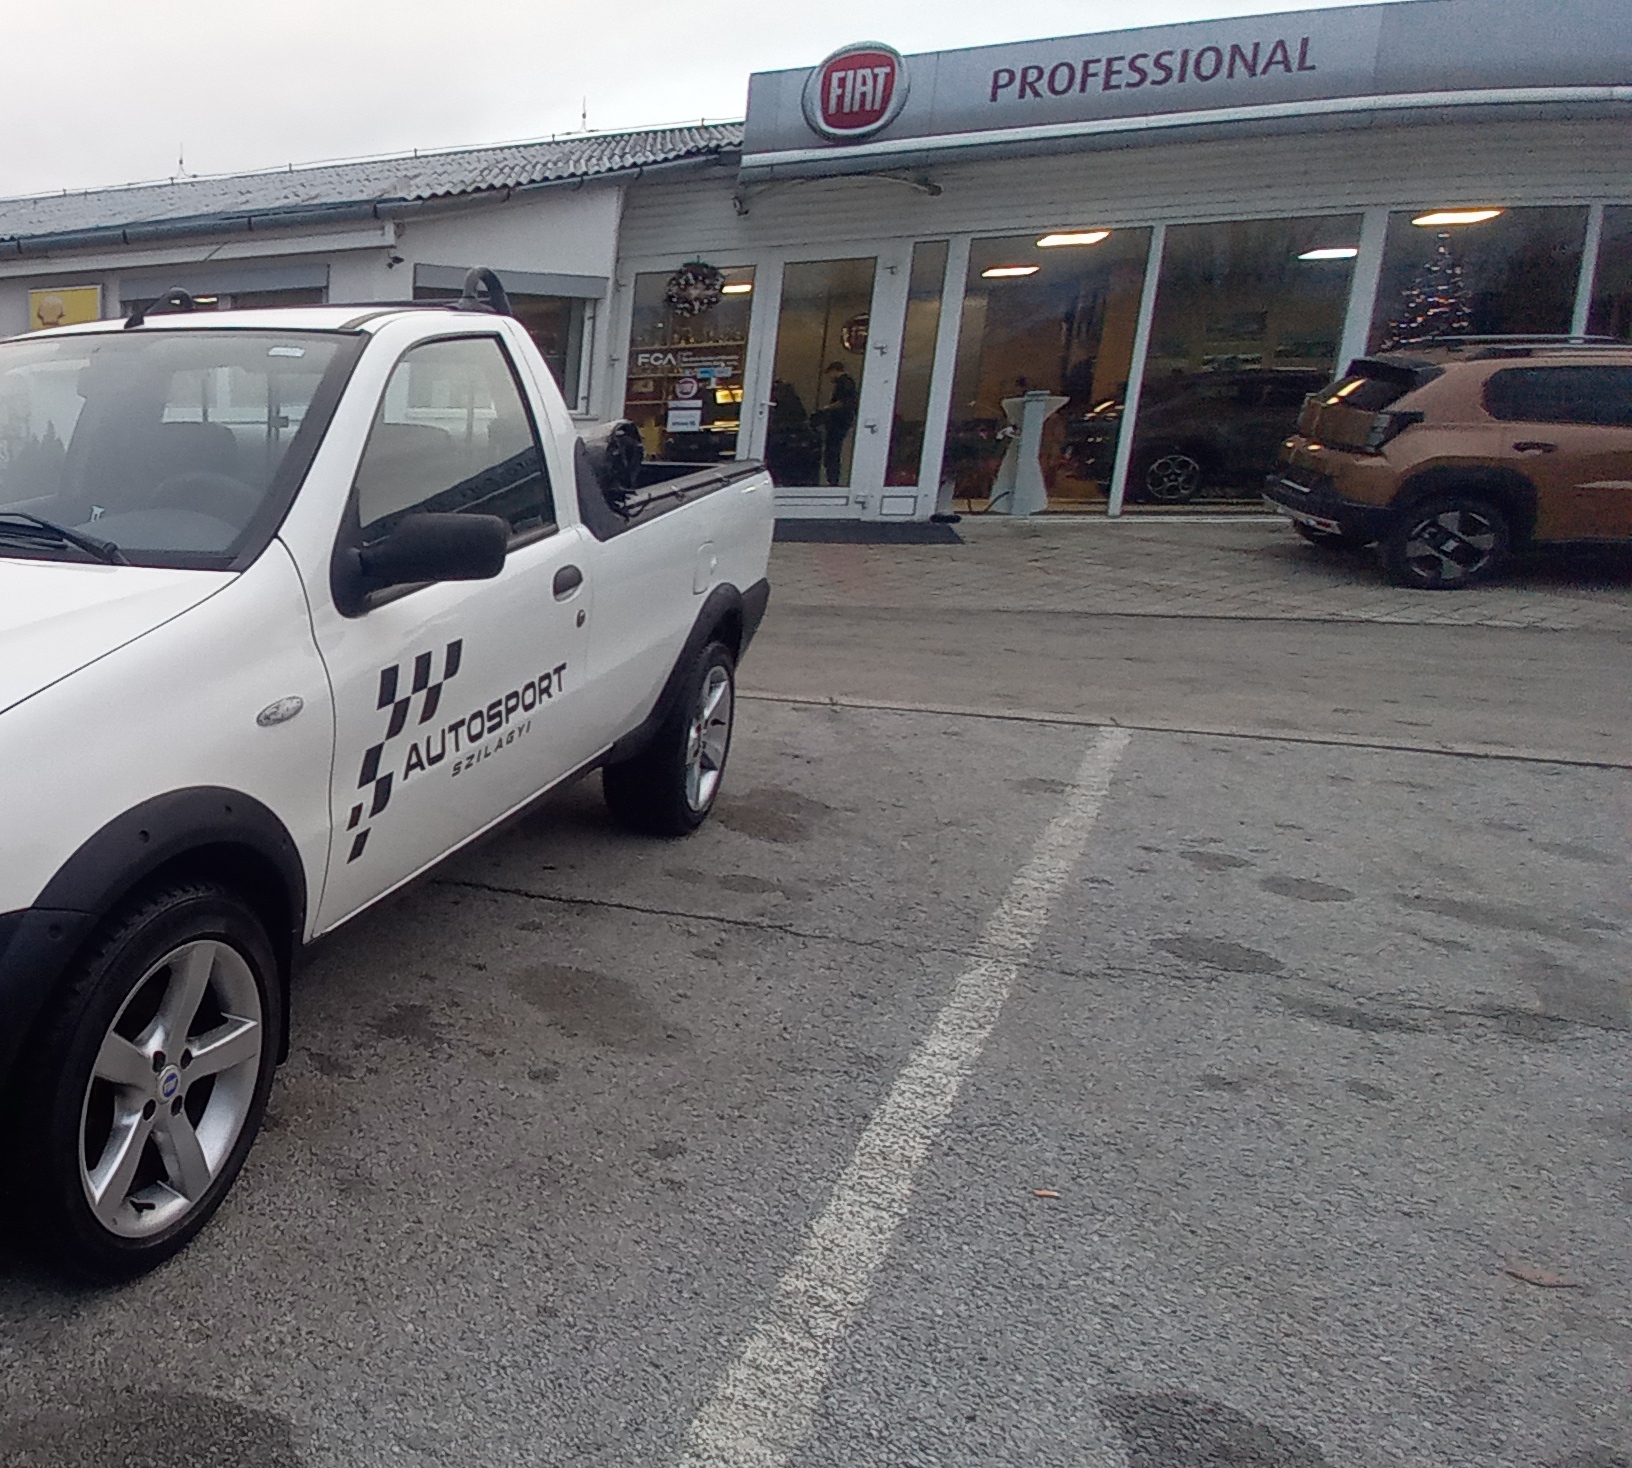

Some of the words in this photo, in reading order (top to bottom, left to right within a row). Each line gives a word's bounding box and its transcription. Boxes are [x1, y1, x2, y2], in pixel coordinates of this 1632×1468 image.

[829, 66, 891, 114] FIAT
[988, 37, 1317, 102] PROFESSIONAL
[403, 662, 567, 781] AUTOSPORT
[452, 721, 531, 777] SZILAGYI
